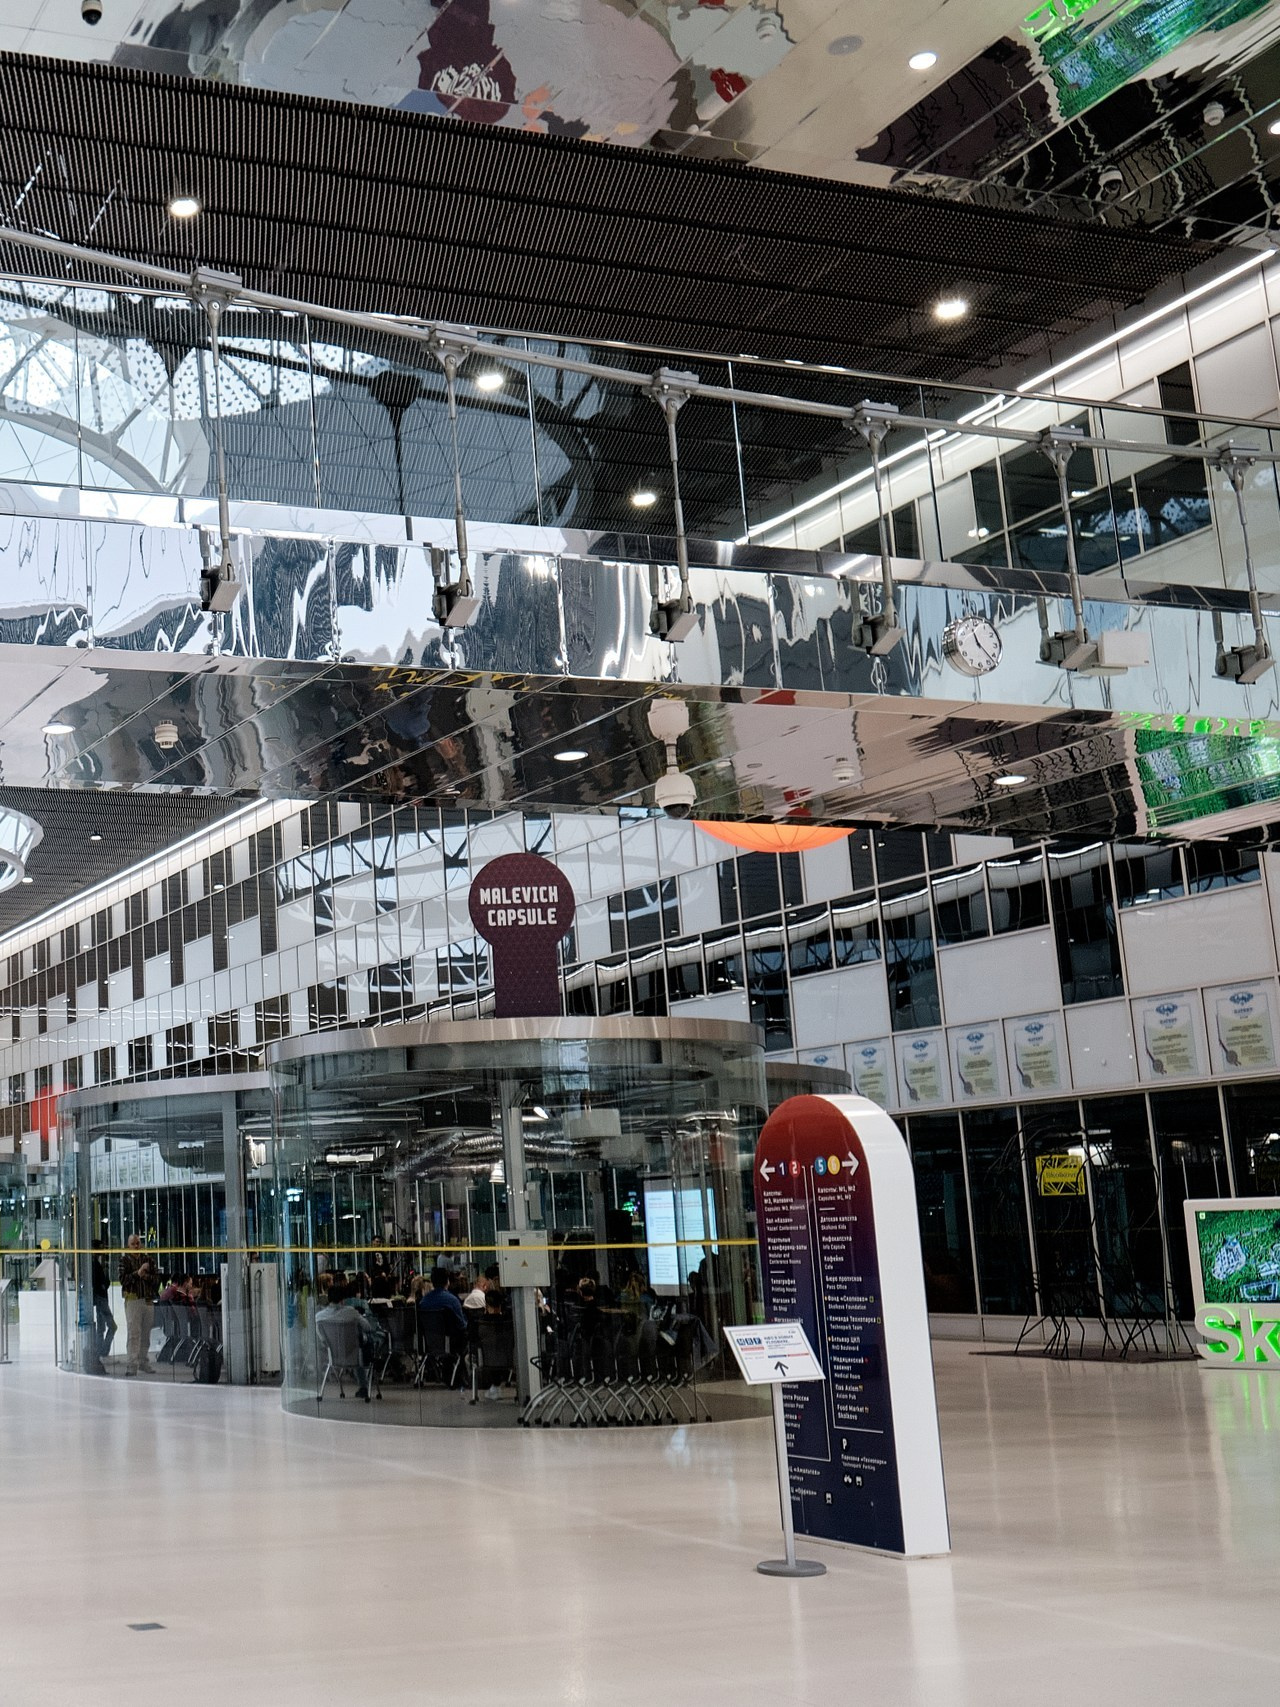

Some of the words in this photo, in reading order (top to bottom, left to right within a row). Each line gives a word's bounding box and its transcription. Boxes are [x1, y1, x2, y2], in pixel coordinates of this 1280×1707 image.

[480, 886, 558, 905] MALEVICH
[488, 908, 557, 926] CAPSULE
[779, 1162, 785, 1176] 1
[792, 1161, 798, 1174] 2
[818, 1160, 824, 1173] 5
[824, 1255, 844, 1263] Кофейня
[850, 1315, 876, 1323] Технопарка
[1195, 1306, 1280, 1363] Sk
[842, 1438, 847, 1450] P
